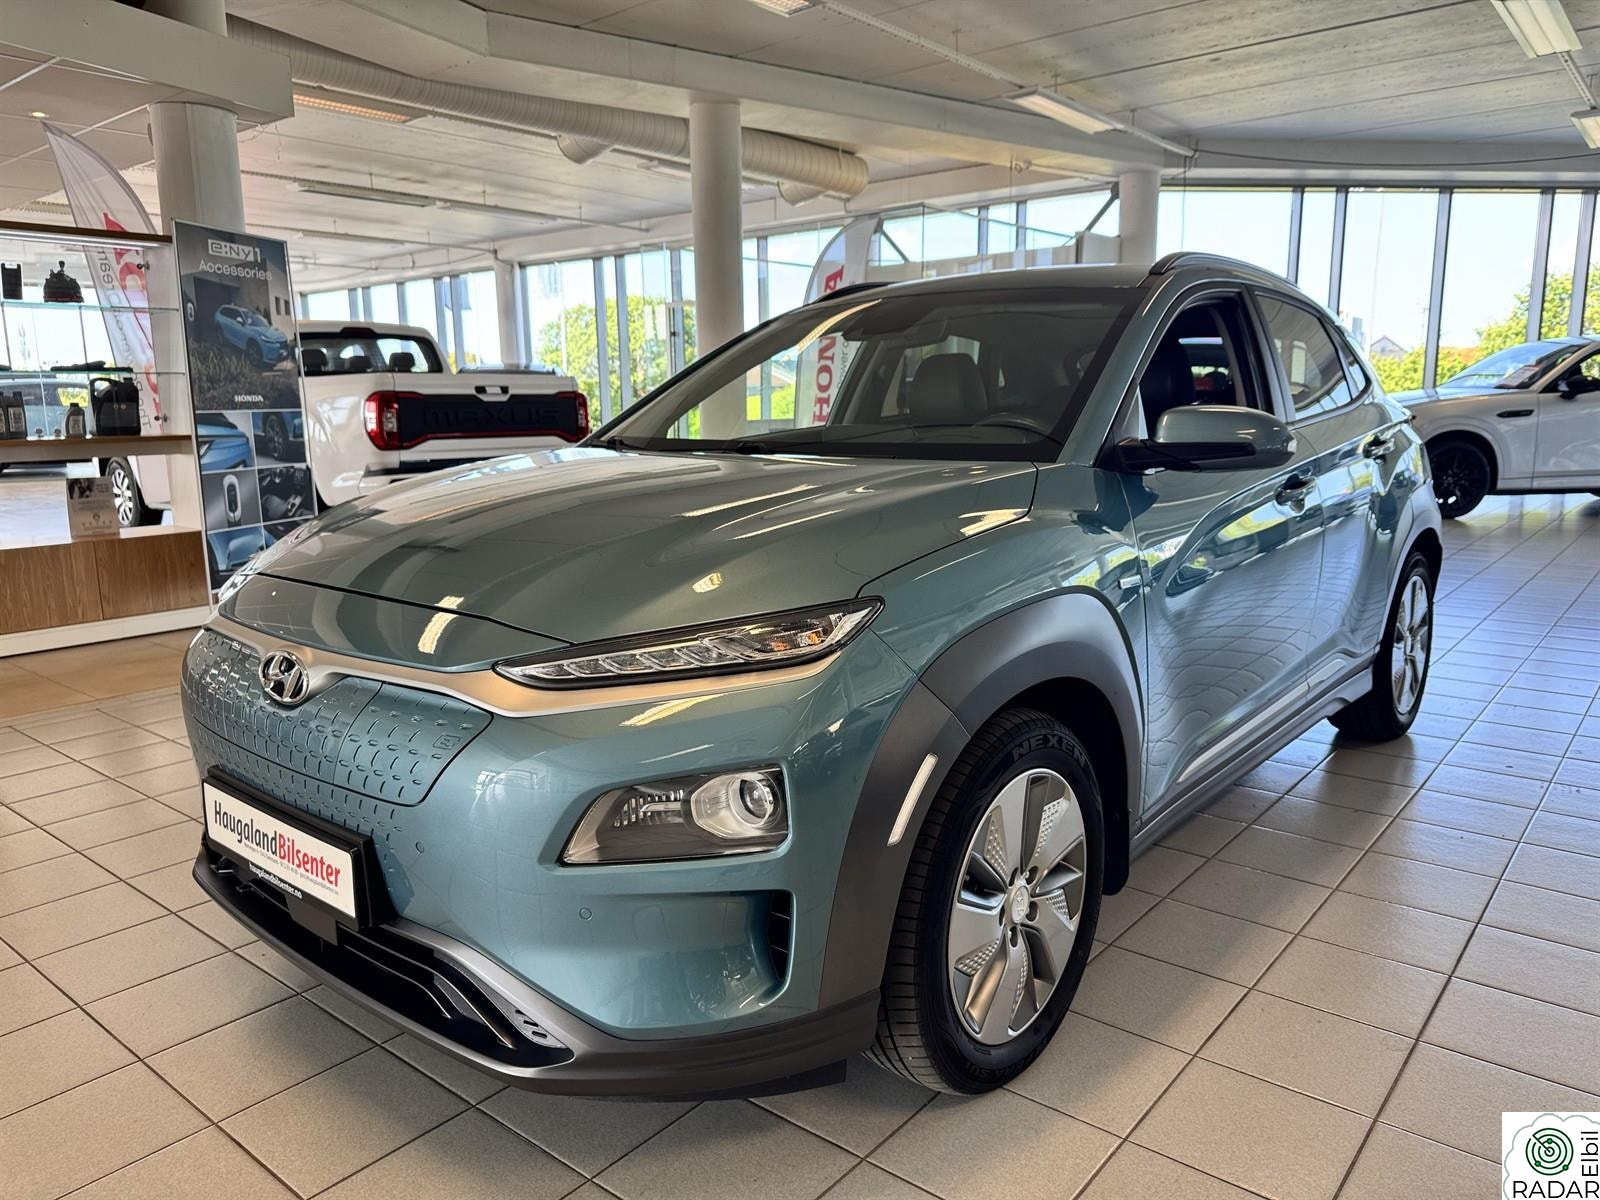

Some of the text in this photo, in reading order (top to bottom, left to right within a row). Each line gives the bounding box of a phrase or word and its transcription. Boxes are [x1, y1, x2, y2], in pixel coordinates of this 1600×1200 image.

[198, 259, 273, 281] Accessories
[234, 394, 265, 403] HONDA
[1011, 734, 1087, 768] NEXEN
[214, 799, 341, 887] HaugalandBilsenter
